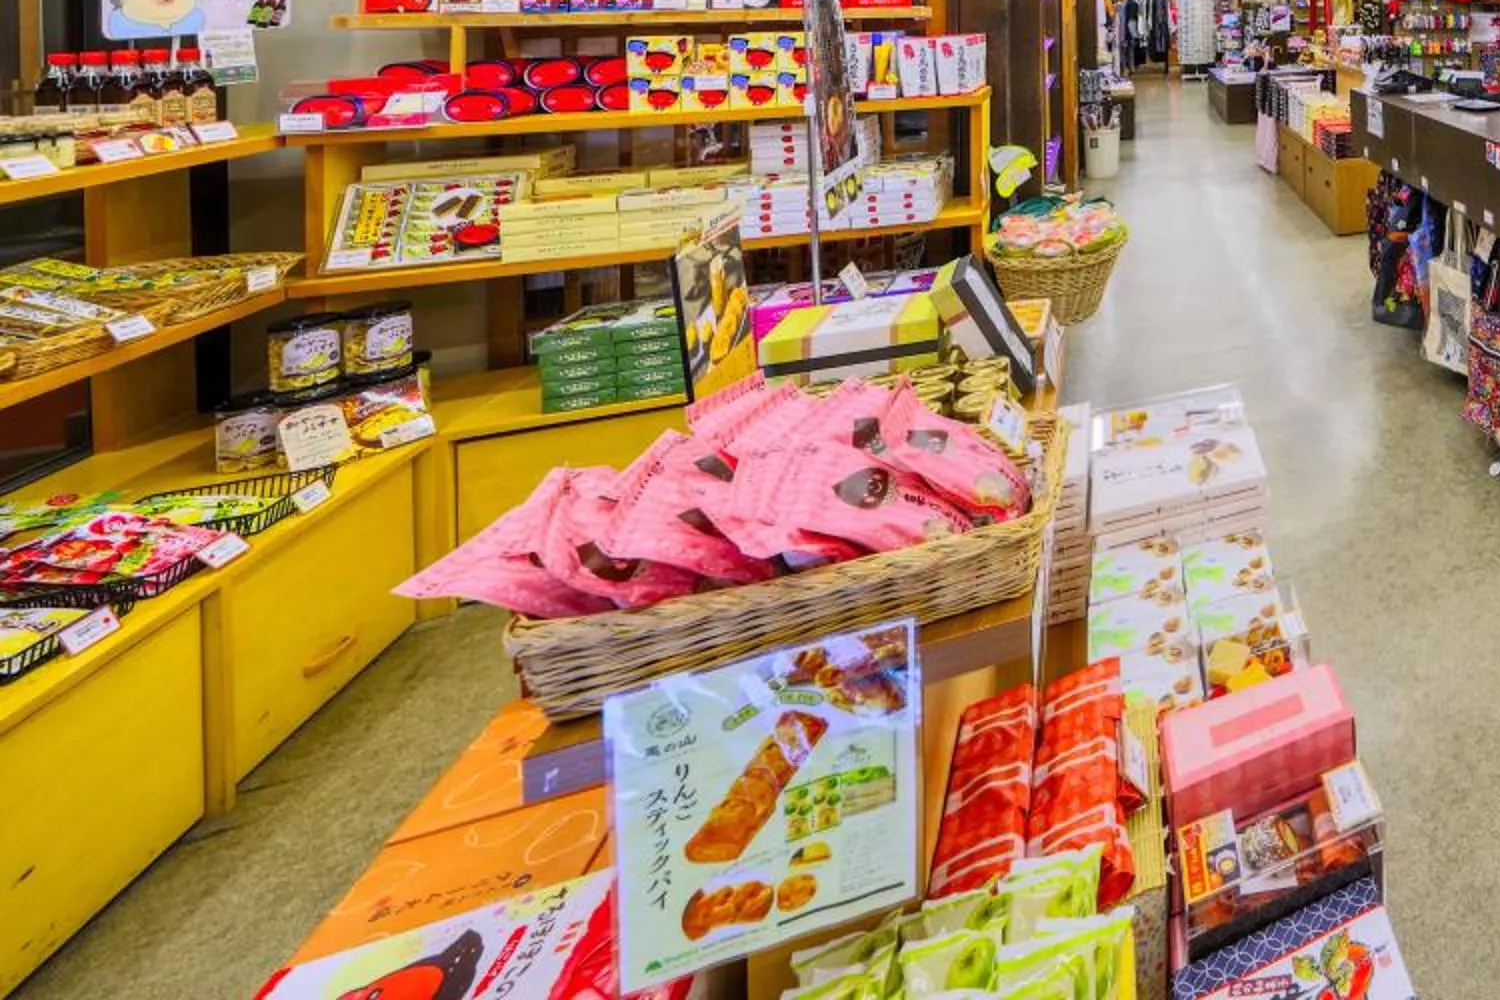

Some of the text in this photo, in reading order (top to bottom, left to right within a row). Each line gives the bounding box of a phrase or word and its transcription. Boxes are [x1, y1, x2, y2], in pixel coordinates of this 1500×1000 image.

[674, 763, 697, 821] りんご
[646, 788, 671, 910] スティックパイ
